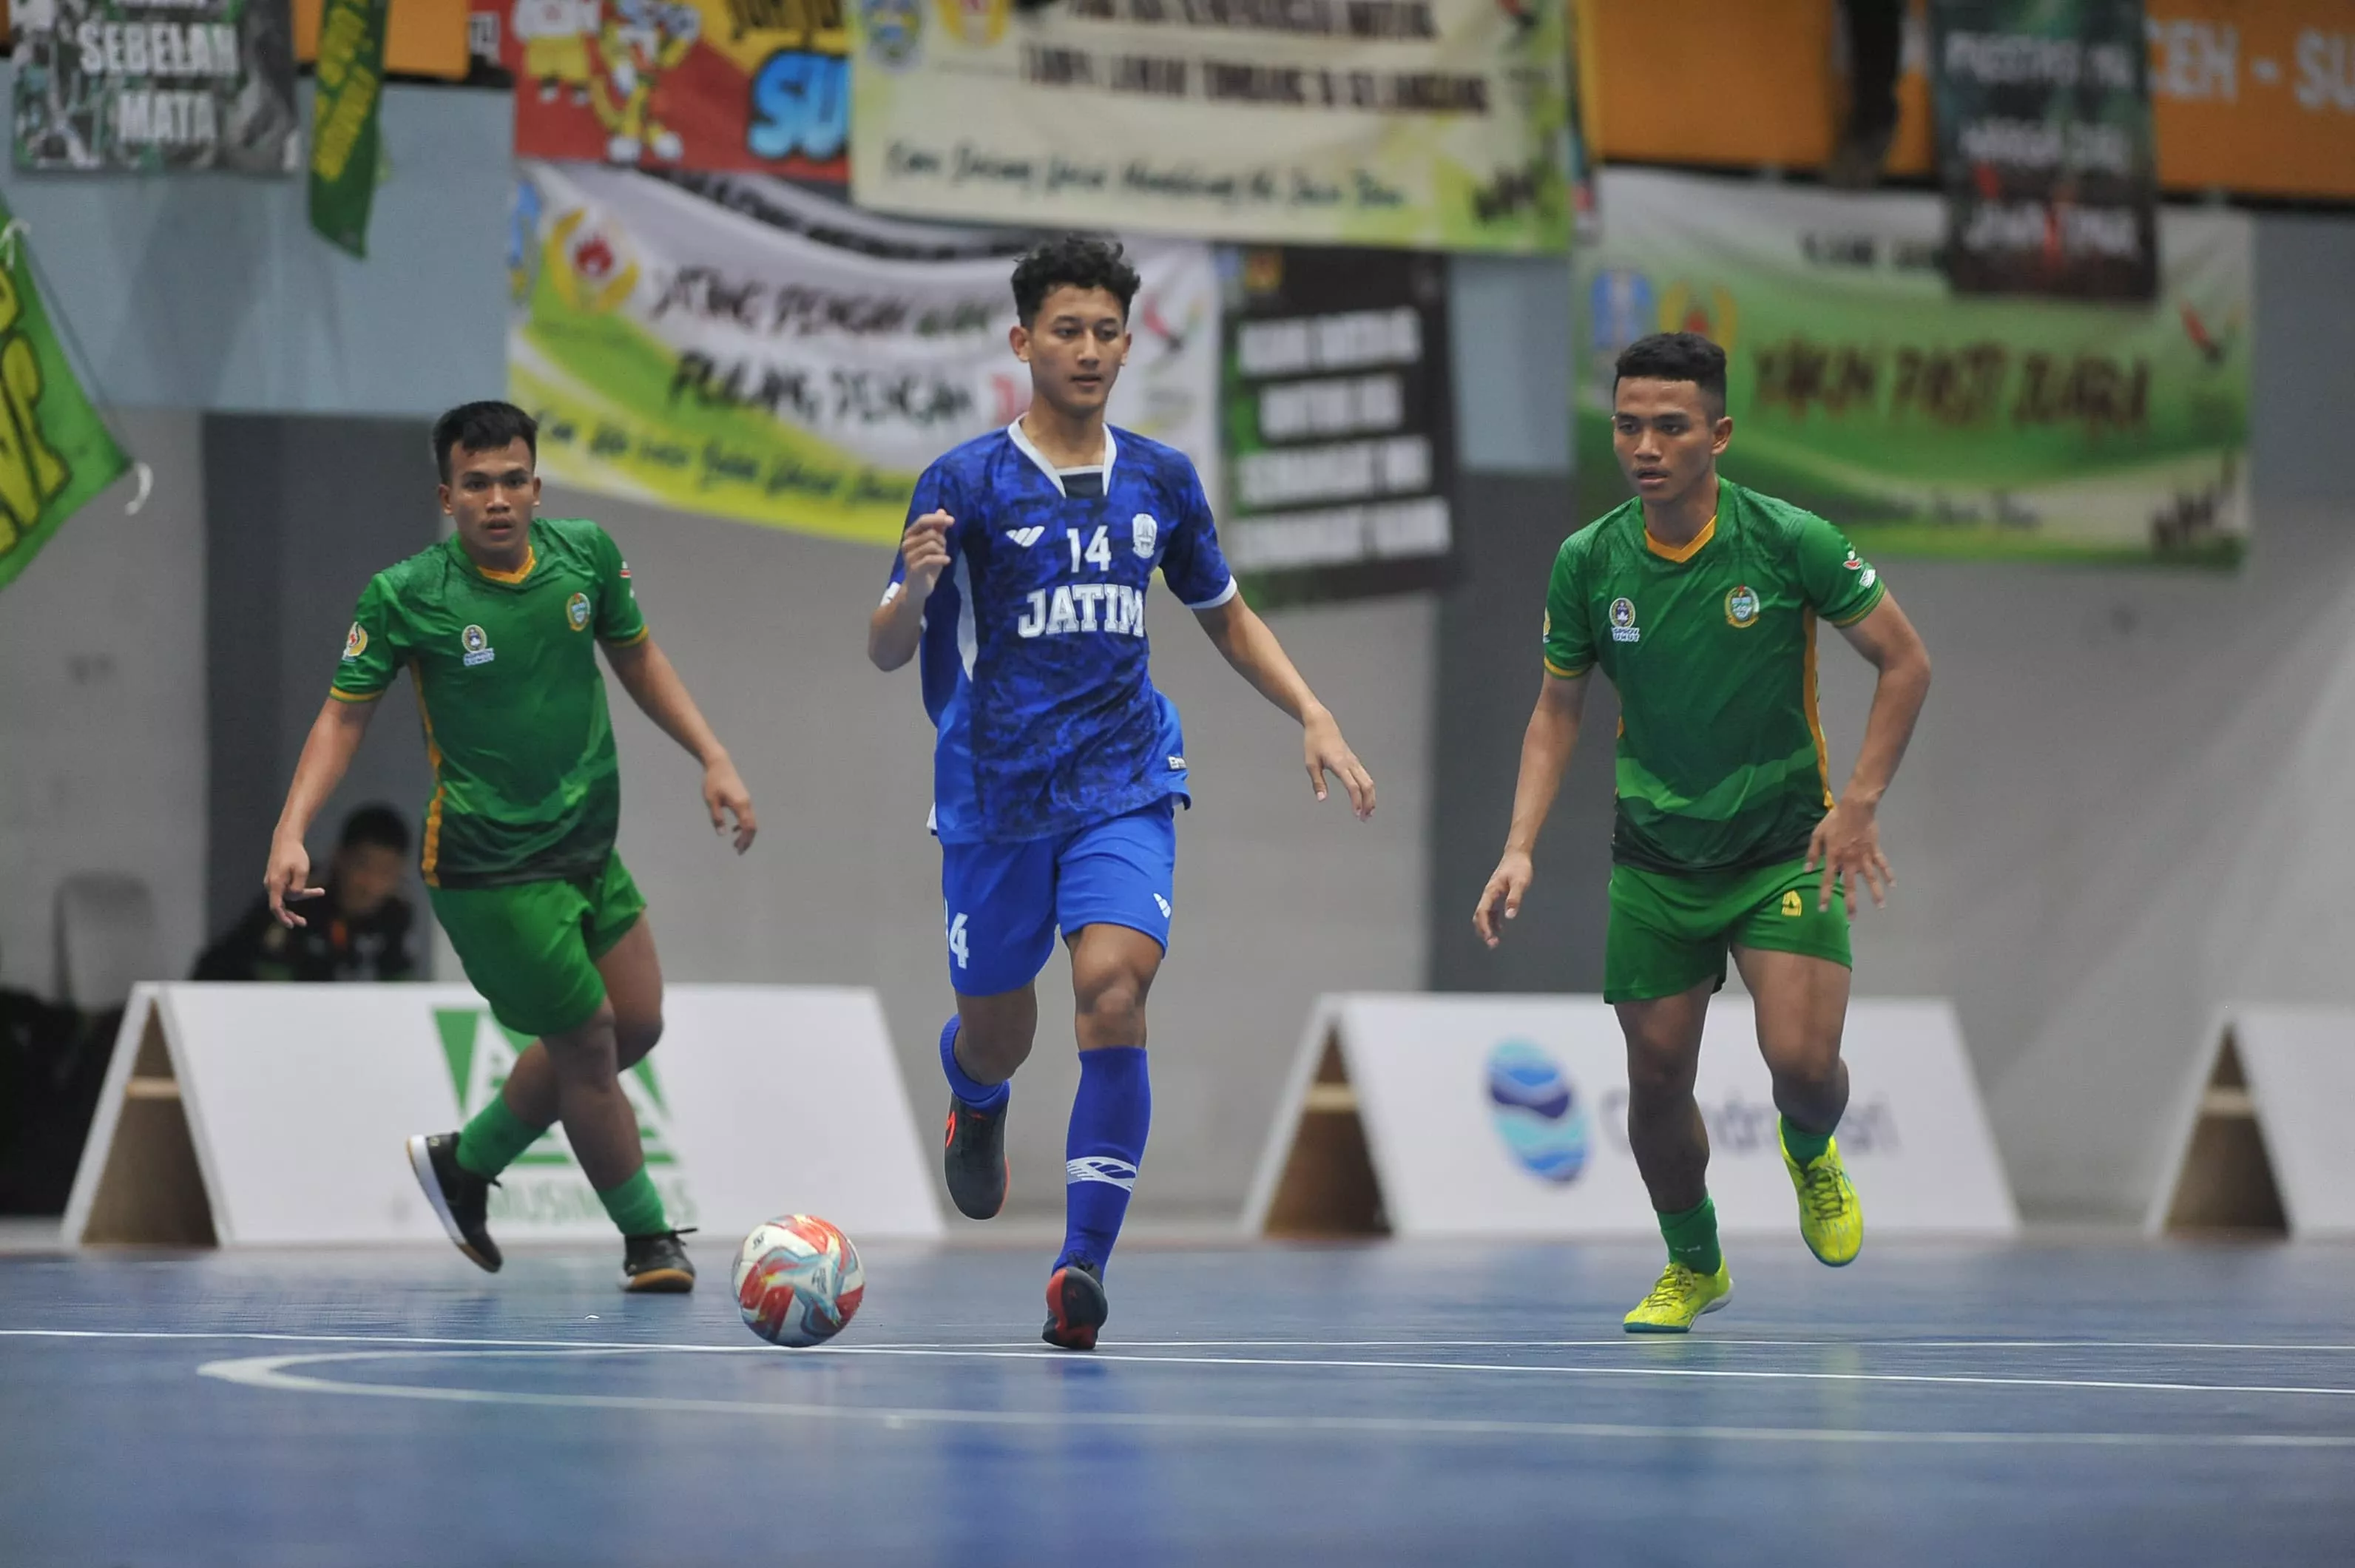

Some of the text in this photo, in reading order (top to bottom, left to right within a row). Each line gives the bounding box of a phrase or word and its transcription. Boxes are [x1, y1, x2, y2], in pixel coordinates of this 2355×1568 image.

[75, 21, 240, 76] SEBELAH
[117, 89, 217, 144] MATA
[1067, 525, 1112, 572] 14
[1018, 583, 1144, 638] JATIM
